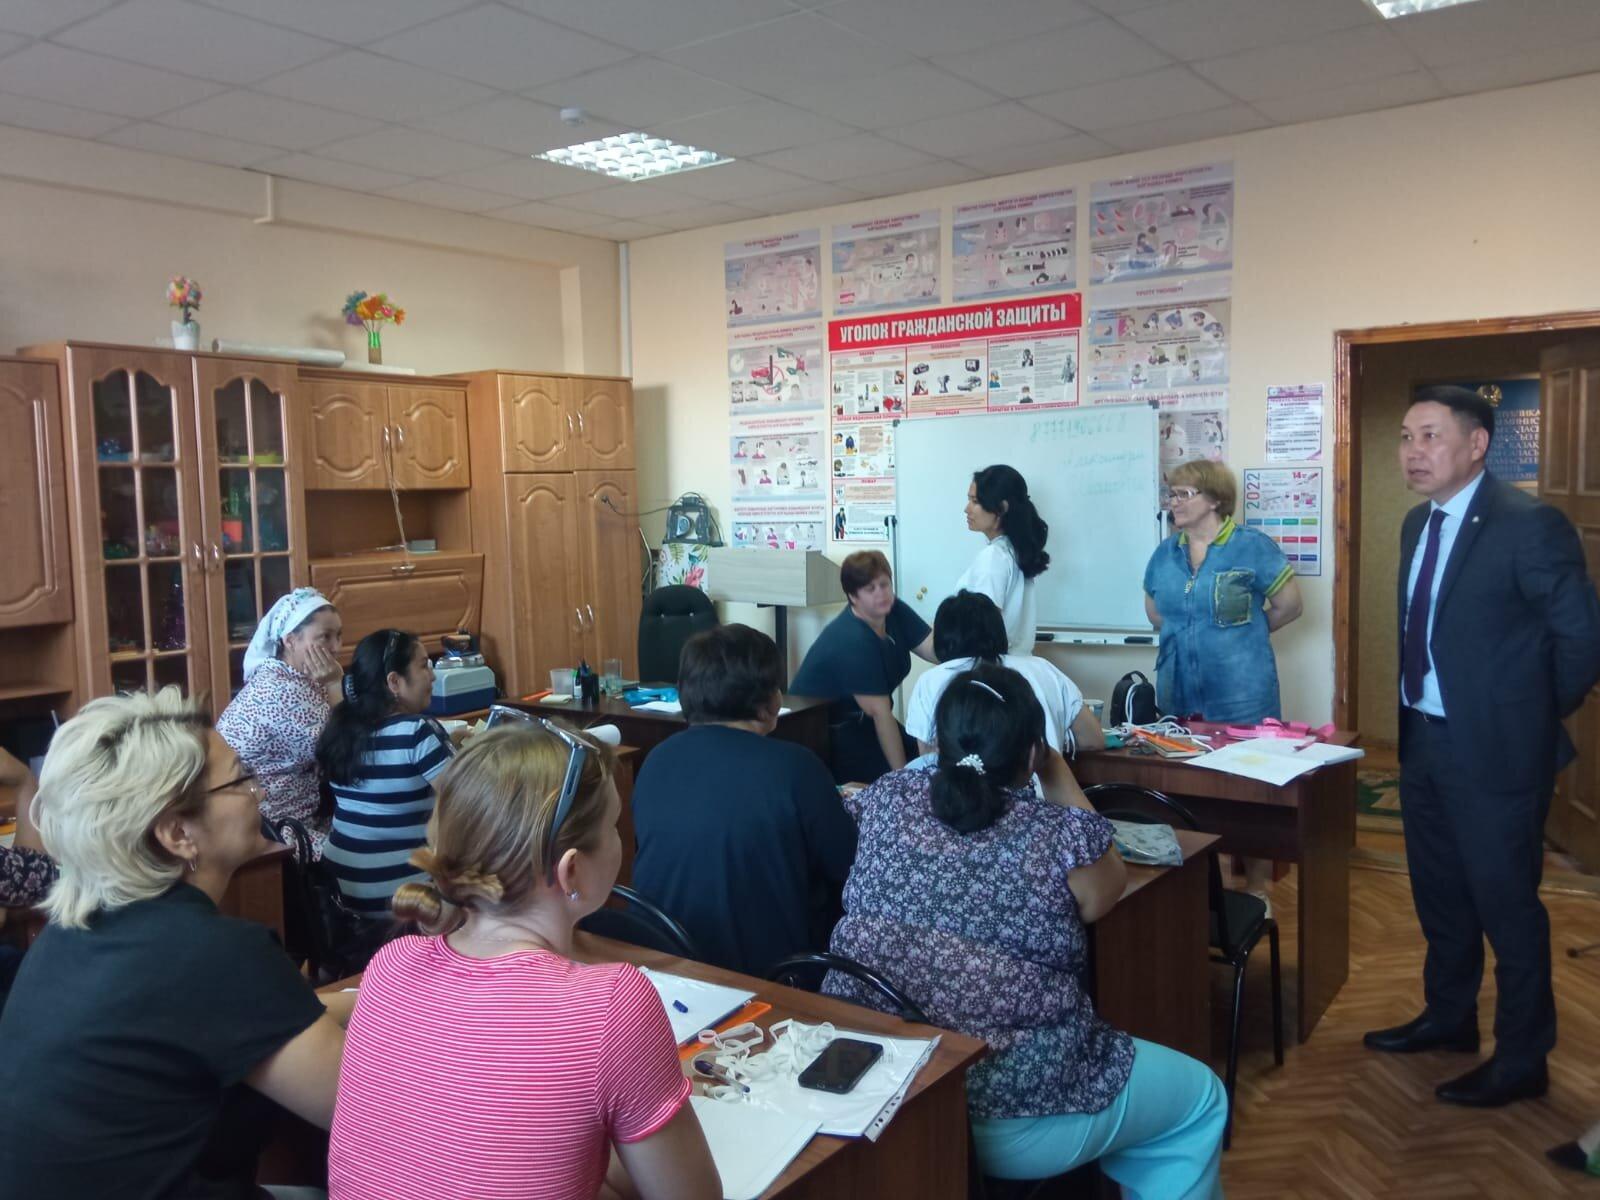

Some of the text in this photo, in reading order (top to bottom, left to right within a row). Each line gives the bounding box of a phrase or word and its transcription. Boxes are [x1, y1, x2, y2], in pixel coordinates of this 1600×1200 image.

[840, 322, 889, 344] УГОЛОК
[891, 308, 994, 339] ГРАЖДАНСКОЙ
[996, 302, 1068, 328] ЗАЩИТЫ
[1246, 472, 1261, 510] 2022
